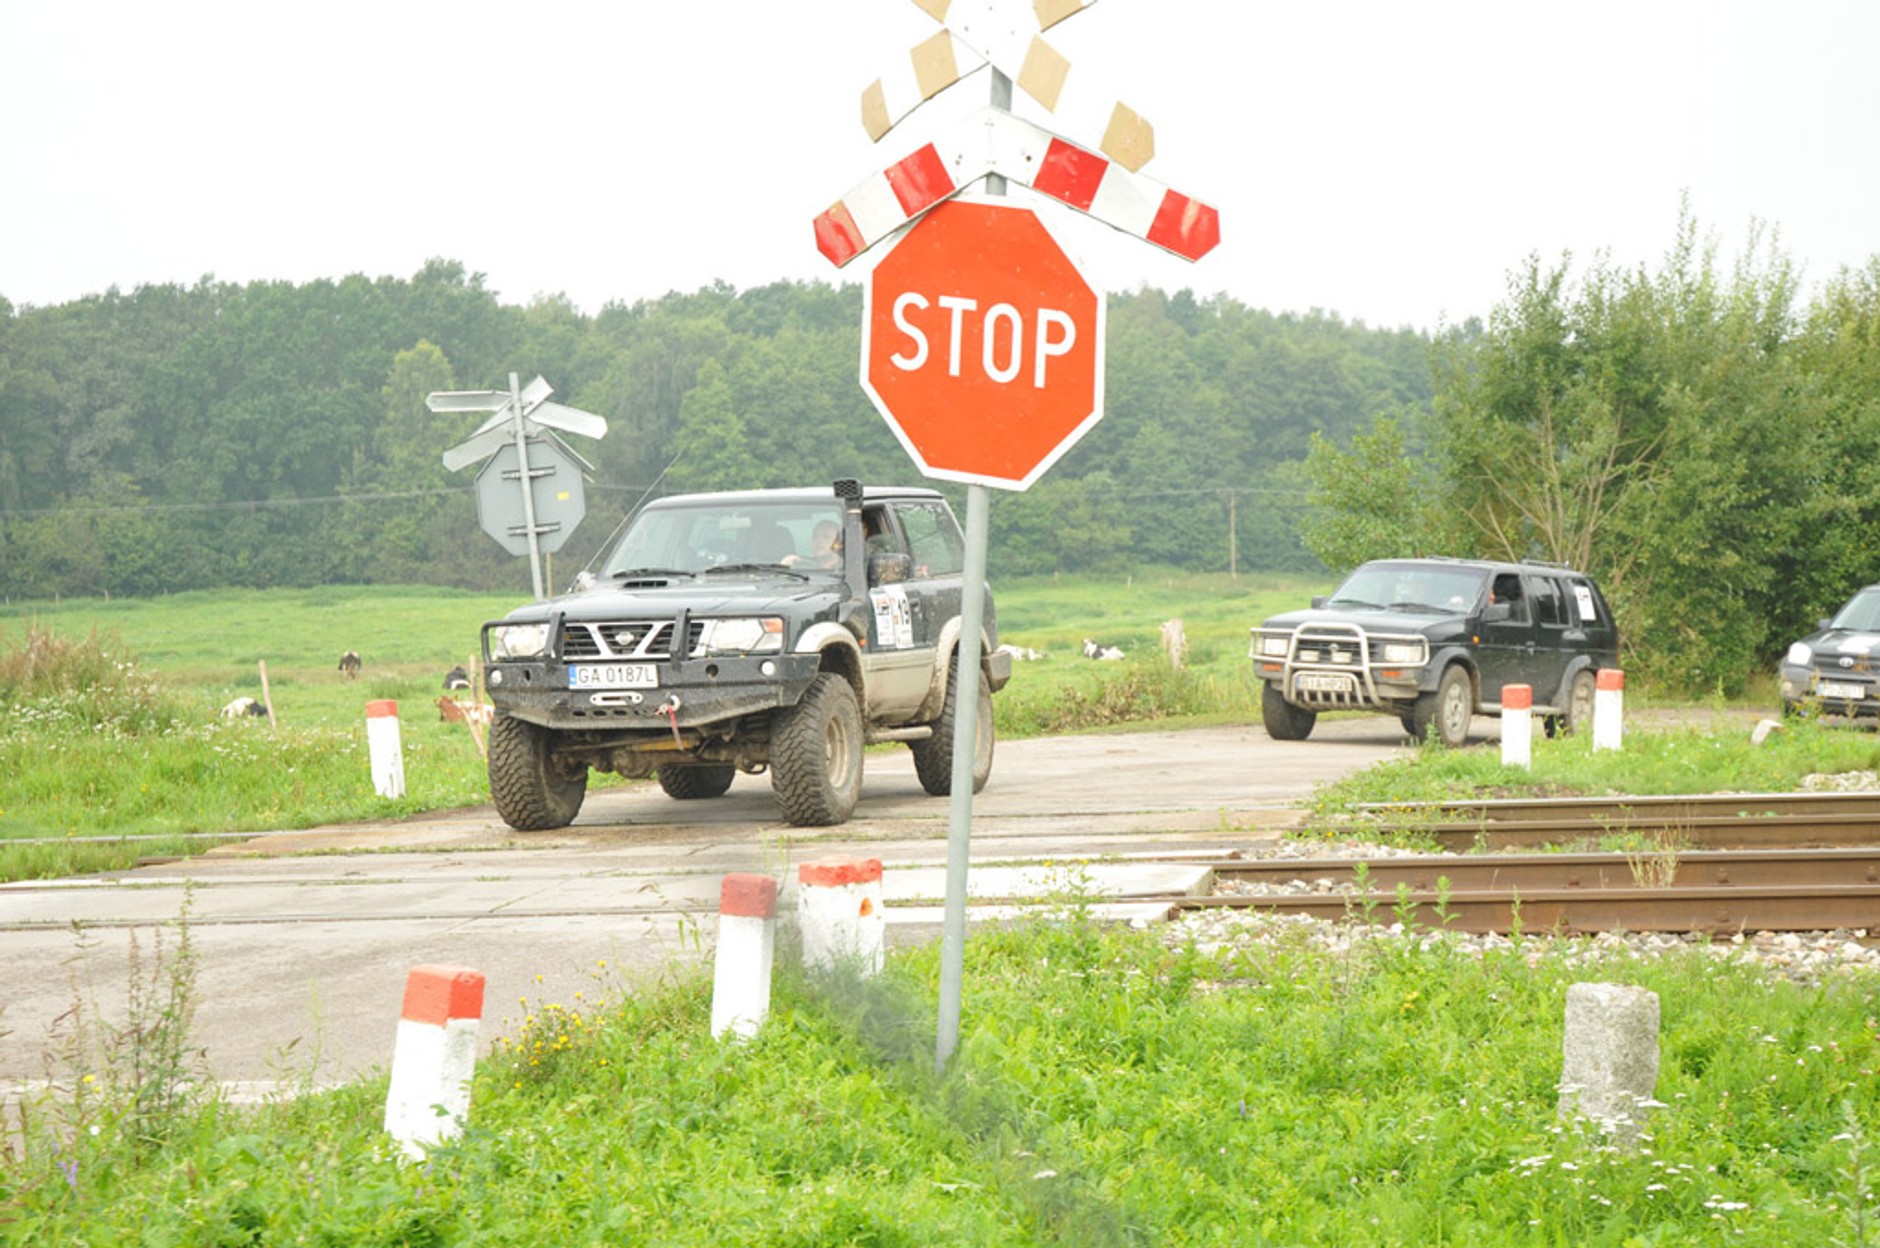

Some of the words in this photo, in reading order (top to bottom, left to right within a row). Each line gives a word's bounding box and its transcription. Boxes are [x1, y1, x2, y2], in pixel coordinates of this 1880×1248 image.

[890, 292, 1076, 388] STOP
[578, 667, 601, 684] GA
[606, 666, 654, 683] 0187L
